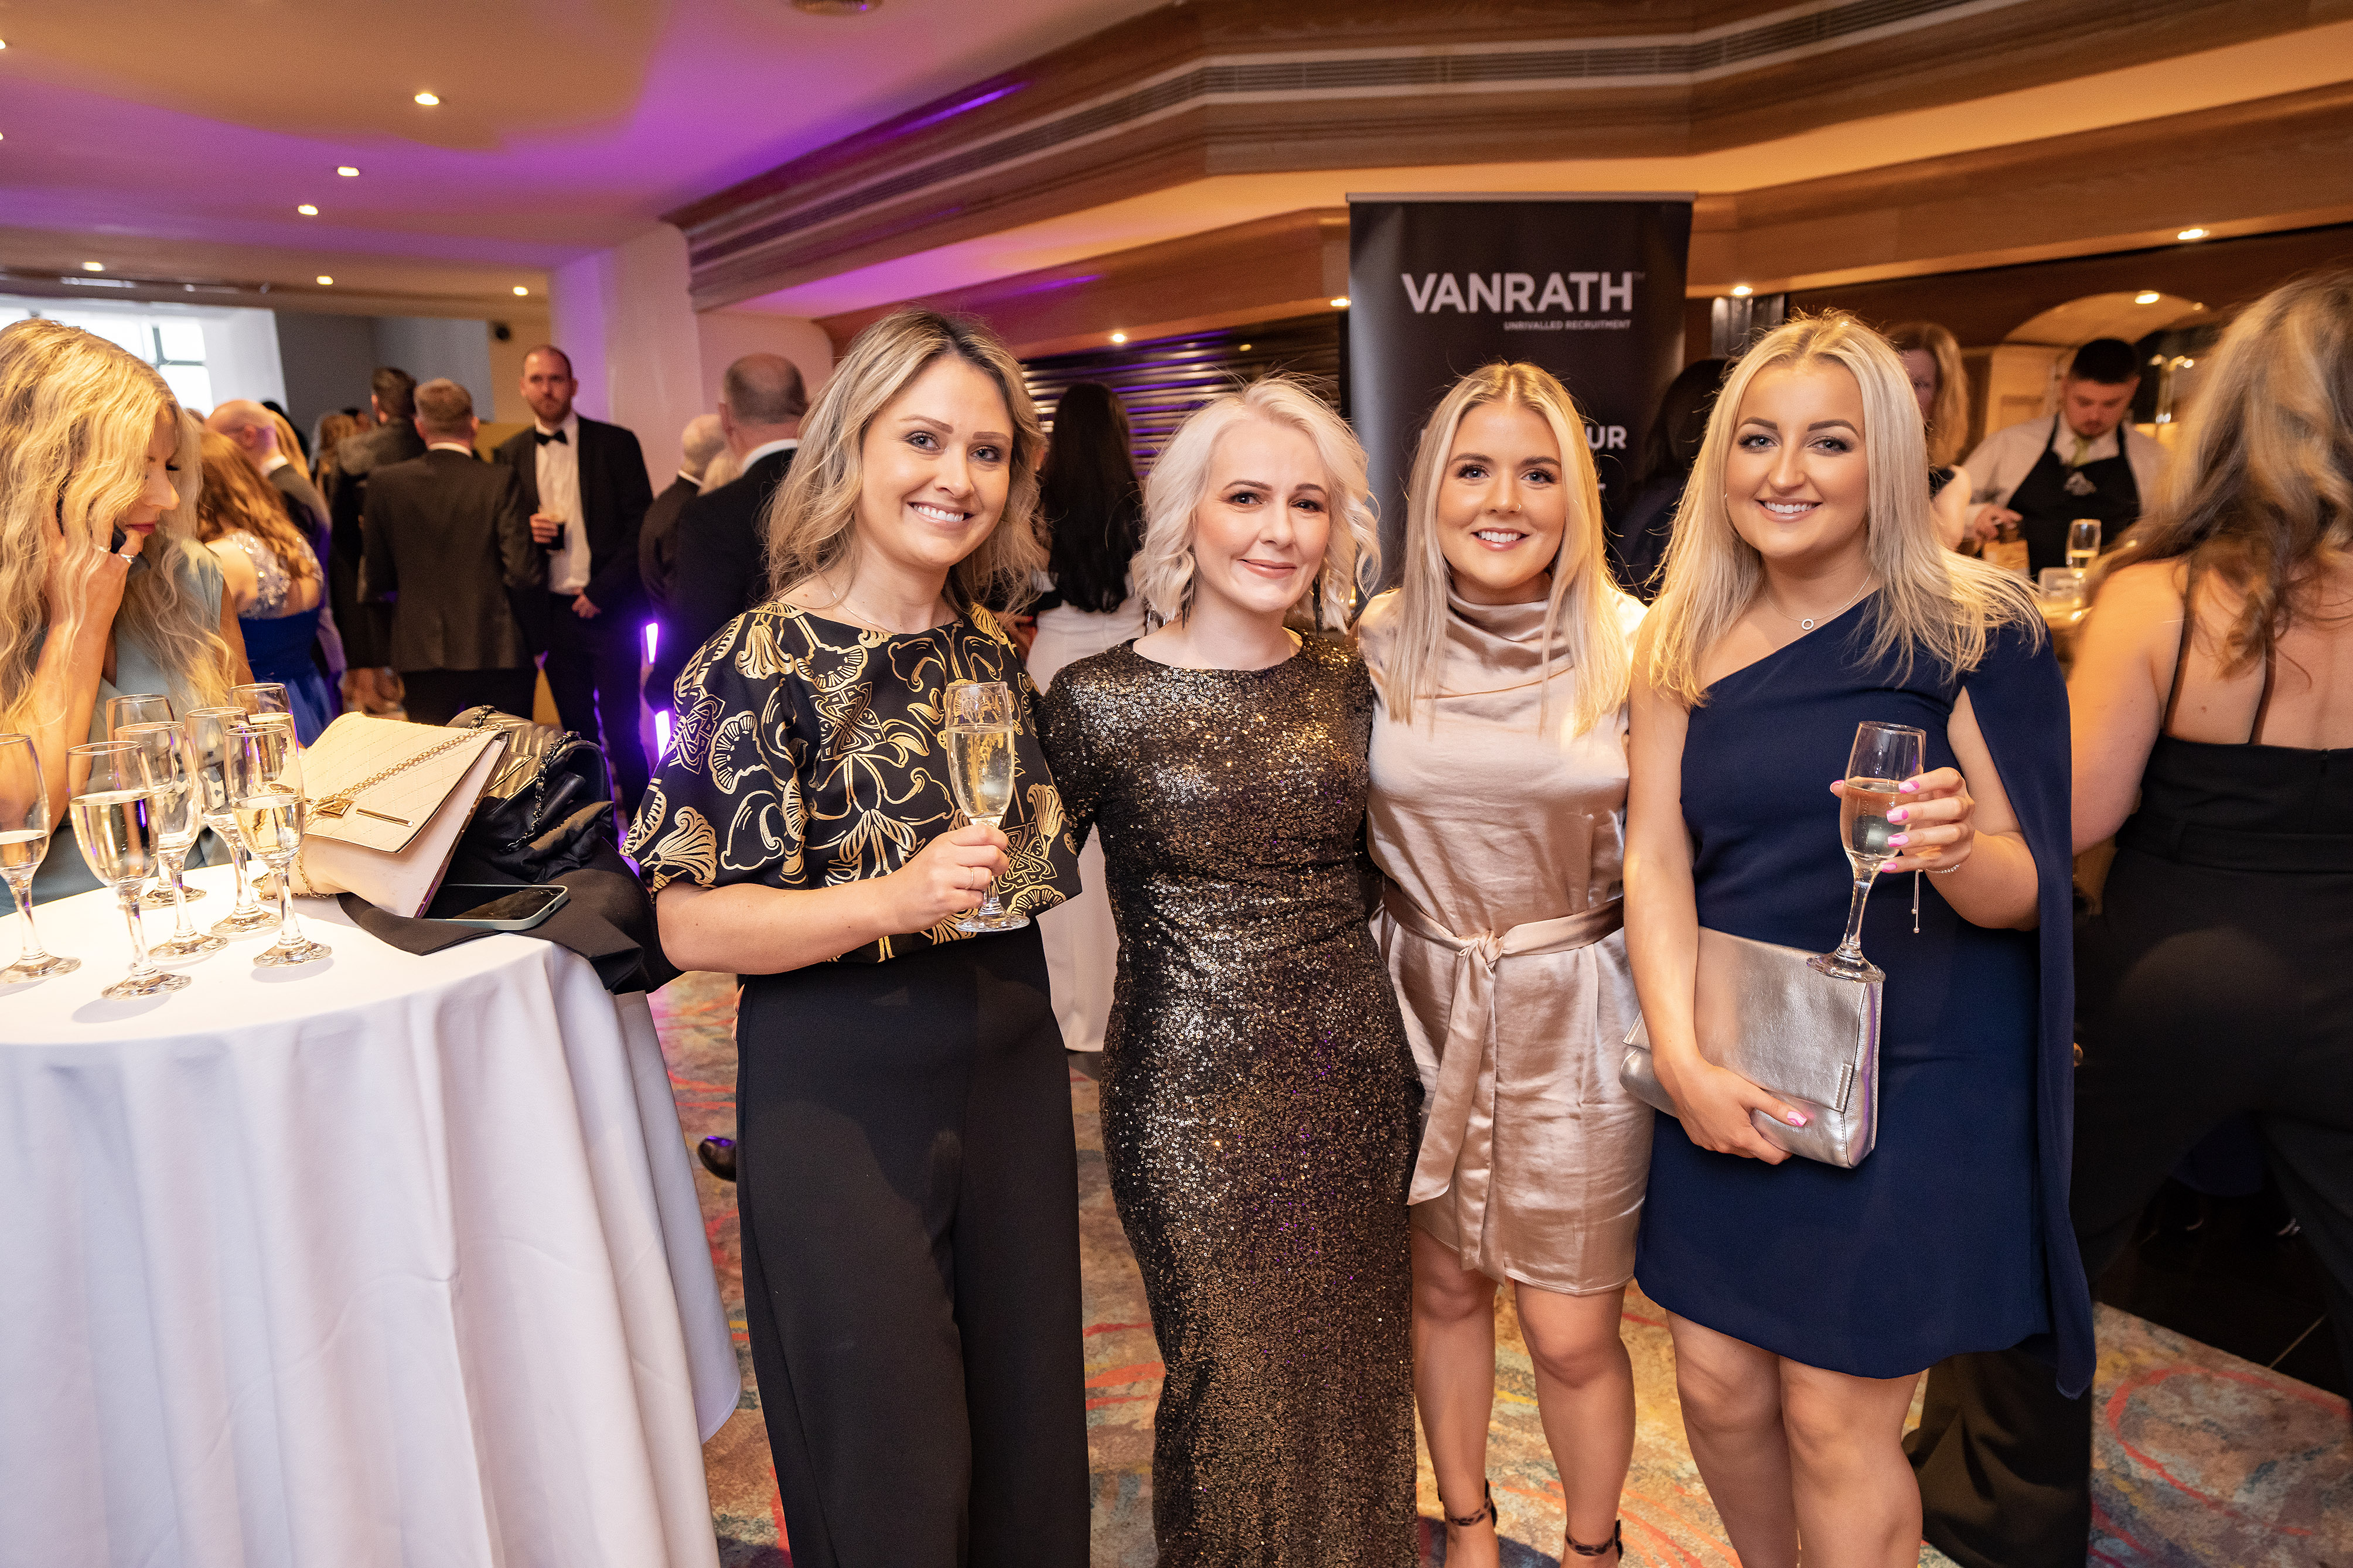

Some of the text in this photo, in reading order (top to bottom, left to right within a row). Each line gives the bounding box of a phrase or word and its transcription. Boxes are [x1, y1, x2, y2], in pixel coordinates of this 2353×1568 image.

[1401, 272, 1633, 313] VANRATH
[1504, 320, 1631, 331] UNRIVALLED RECRUITMENT
[1585, 425, 1628, 450] UR
